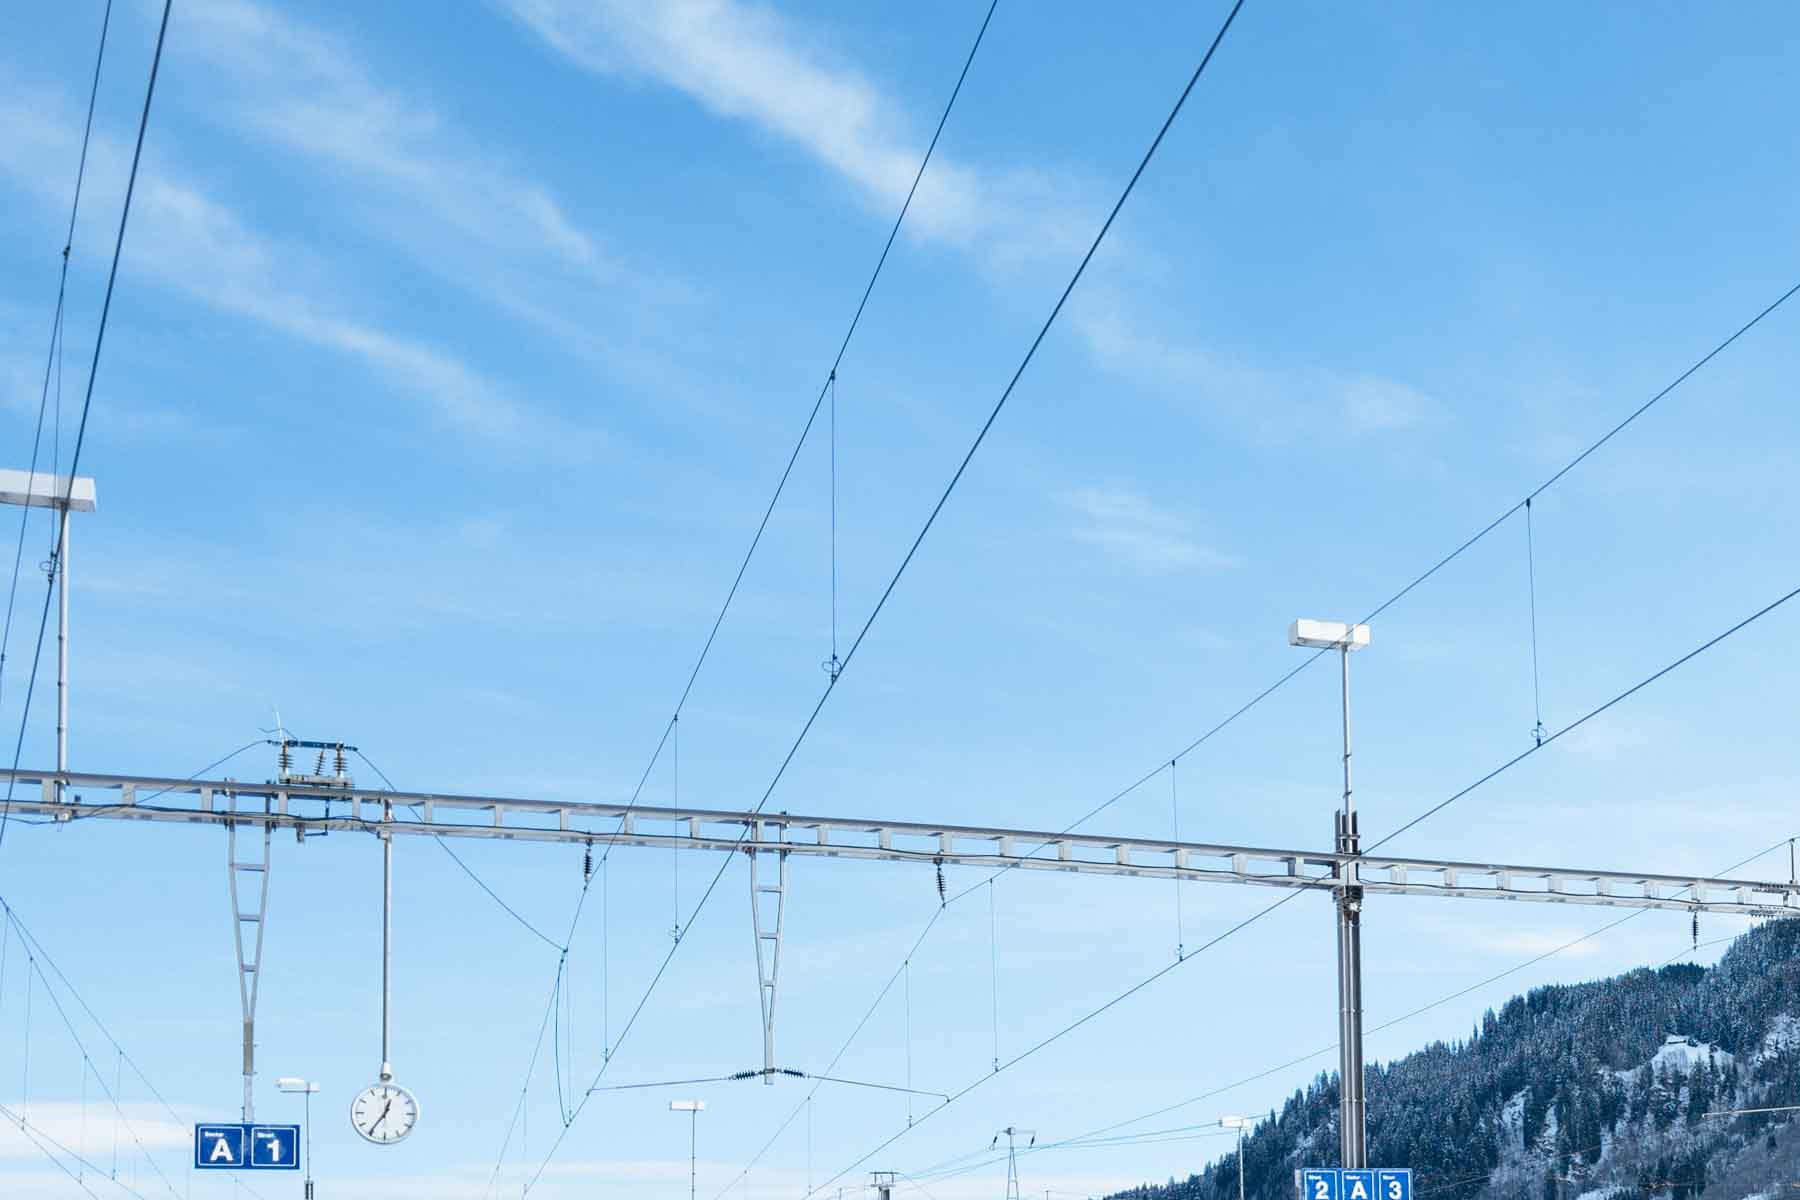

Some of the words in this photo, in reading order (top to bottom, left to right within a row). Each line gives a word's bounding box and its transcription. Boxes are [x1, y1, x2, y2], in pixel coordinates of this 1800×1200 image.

[210, 1138, 234, 1161] A
[266, 1139, 280, 1162] 1
[1315, 1180, 1329, 1200] 2
[1350, 1180, 1368, 1200] A
[1388, 1180, 1402, 1200] 3
